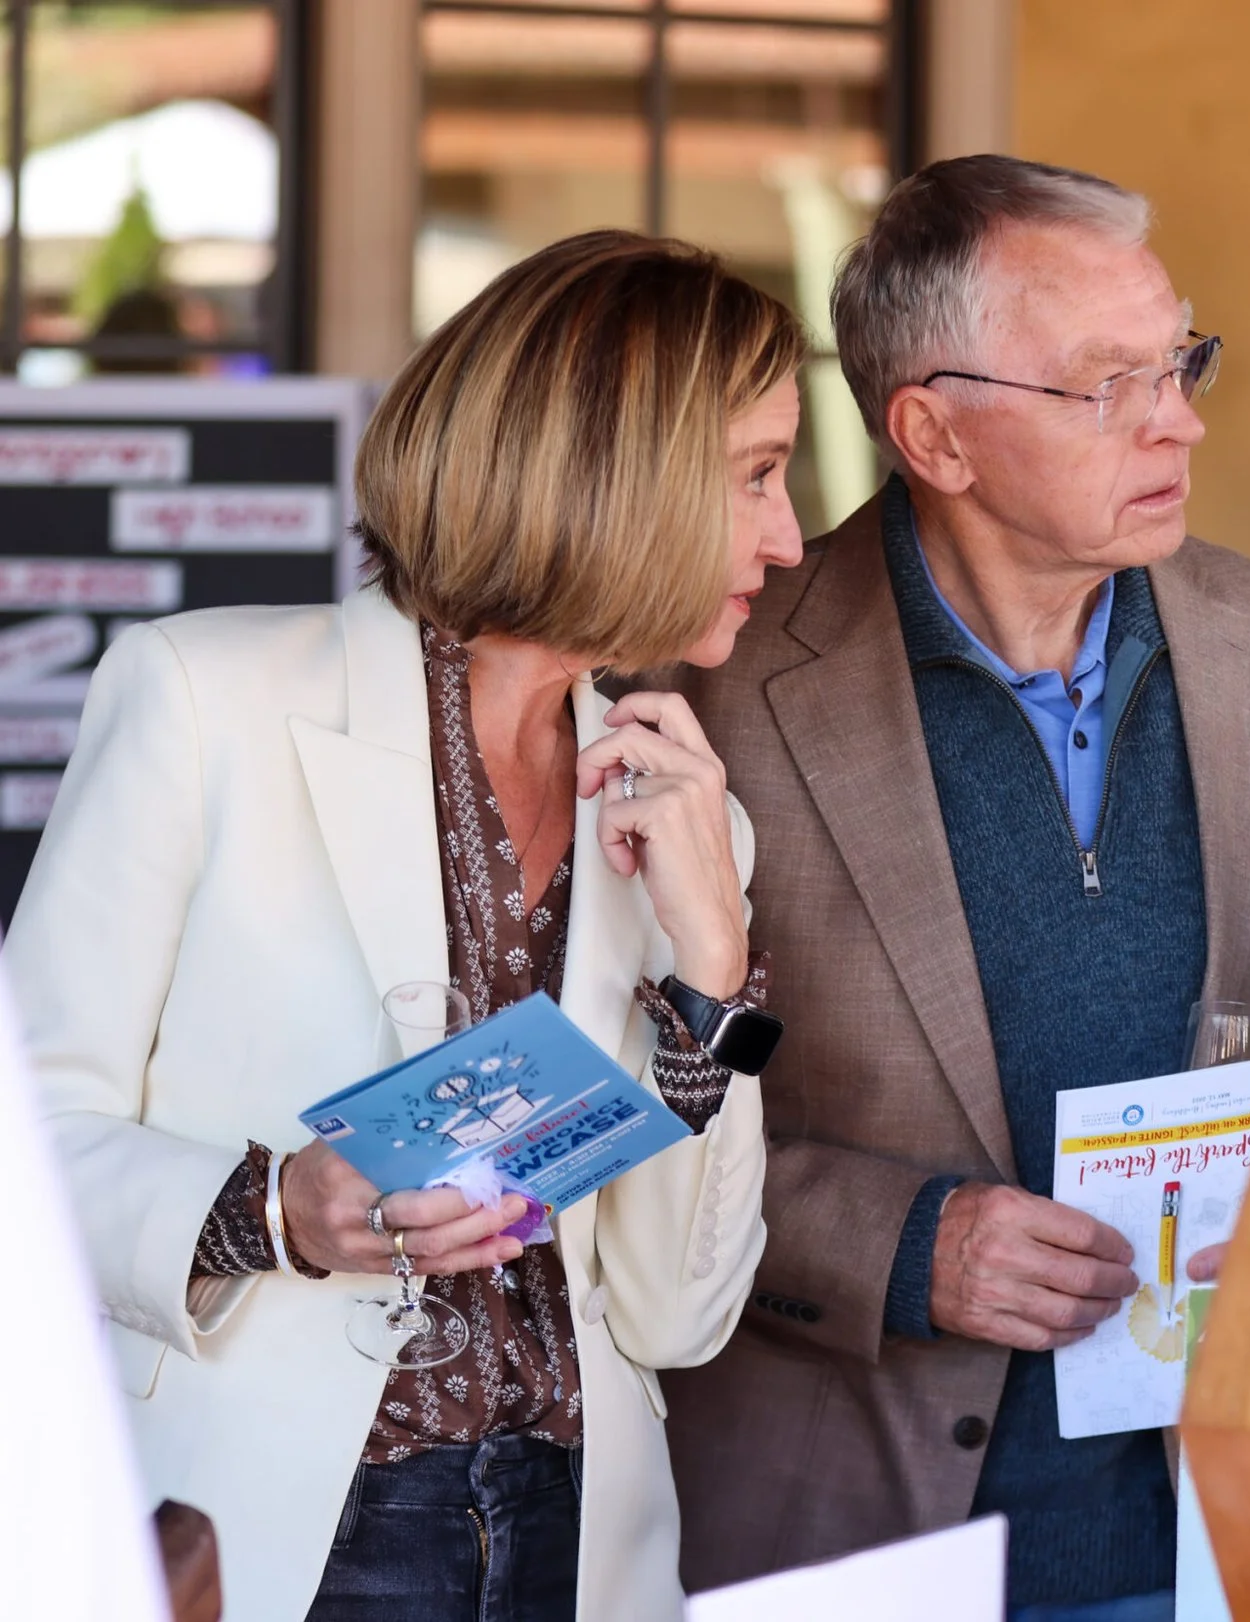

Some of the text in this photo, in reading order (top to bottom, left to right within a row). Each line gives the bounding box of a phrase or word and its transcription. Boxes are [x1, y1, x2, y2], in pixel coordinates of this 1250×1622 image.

[497, 1099, 588, 1158] the future!
[508, 1103, 639, 1180] WCASE
[527, 1096, 623, 1155] PROJECT
[1138, 1130, 1173, 1142] IGNITE
[1223, 1119, 1236, 1128] an
[1079, 1147, 1155, 1185] future!
[1160, 1147, 1196, 1174] the
